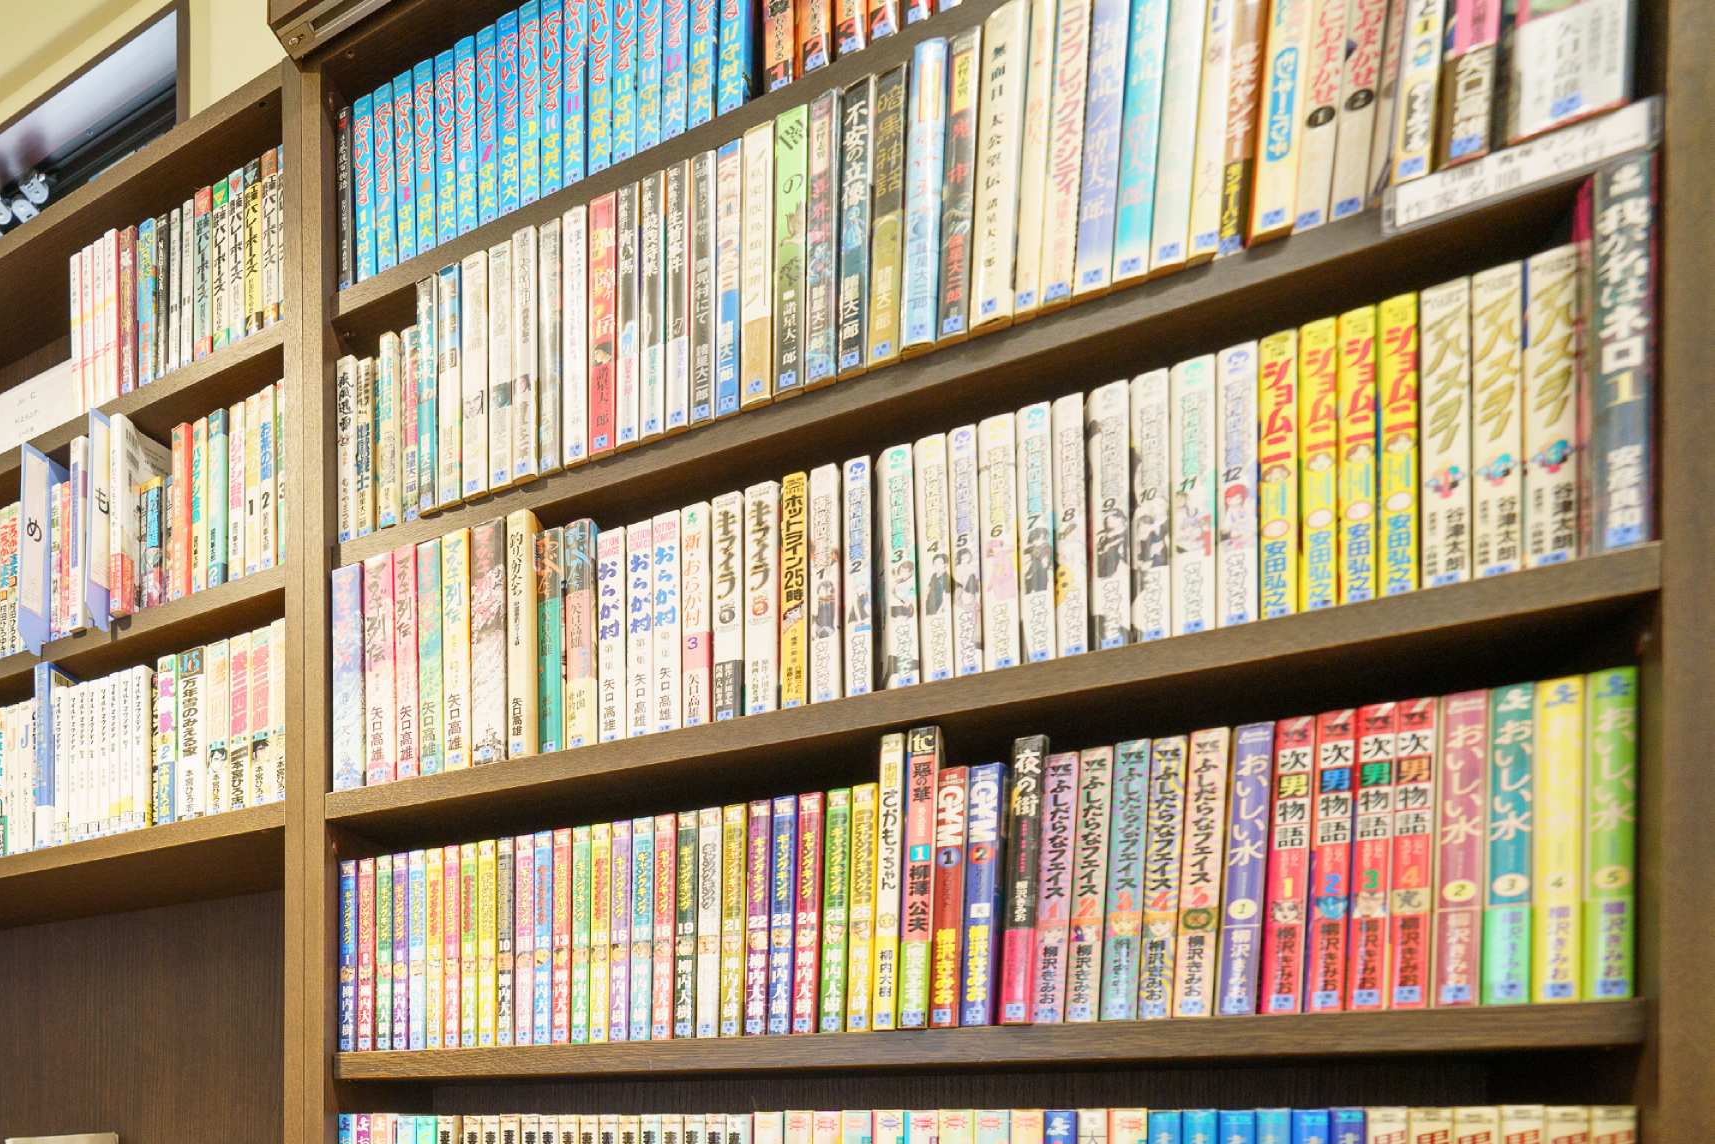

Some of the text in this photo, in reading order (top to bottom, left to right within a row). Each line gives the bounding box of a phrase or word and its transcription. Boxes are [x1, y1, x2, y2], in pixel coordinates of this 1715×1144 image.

[843, 99, 869, 208] 不安の立像
[1261, 358, 1294, 464] ショムニ
[1305, 346, 1335, 451] ショムニ
[1344, 337, 1376, 443] ショムニ
[1385, 325, 1417, 433] ショムニ
[26, 518, 43, 544] め
[598, 561, 620, 641] おらが村
[630, 554, 652, 634] おらが村
[654, 545, 676, 627] おらが村
[1014, 751, 1042, 817] 夜の街
[1078, 776, 1102, 897] ふしだらなフェイス
[1148, 766, 1179, 891] ふしだらなフェイス
[1188, 757, 1218, 885] ふしだらなフェイス
[1229, 753, 1269, 867] おいしい水
[1278, 748, 1309, 849] 次男物語
[1319, 743, 1354, 844] 次男物語
[1359, 735, 1392, 890] 次男物語 3
[1397, 732, 1431, 836] 次男物語
[942, 850, 953, 865] 1
[1045, 779, 1071, 898] ふしだらなフェイス
